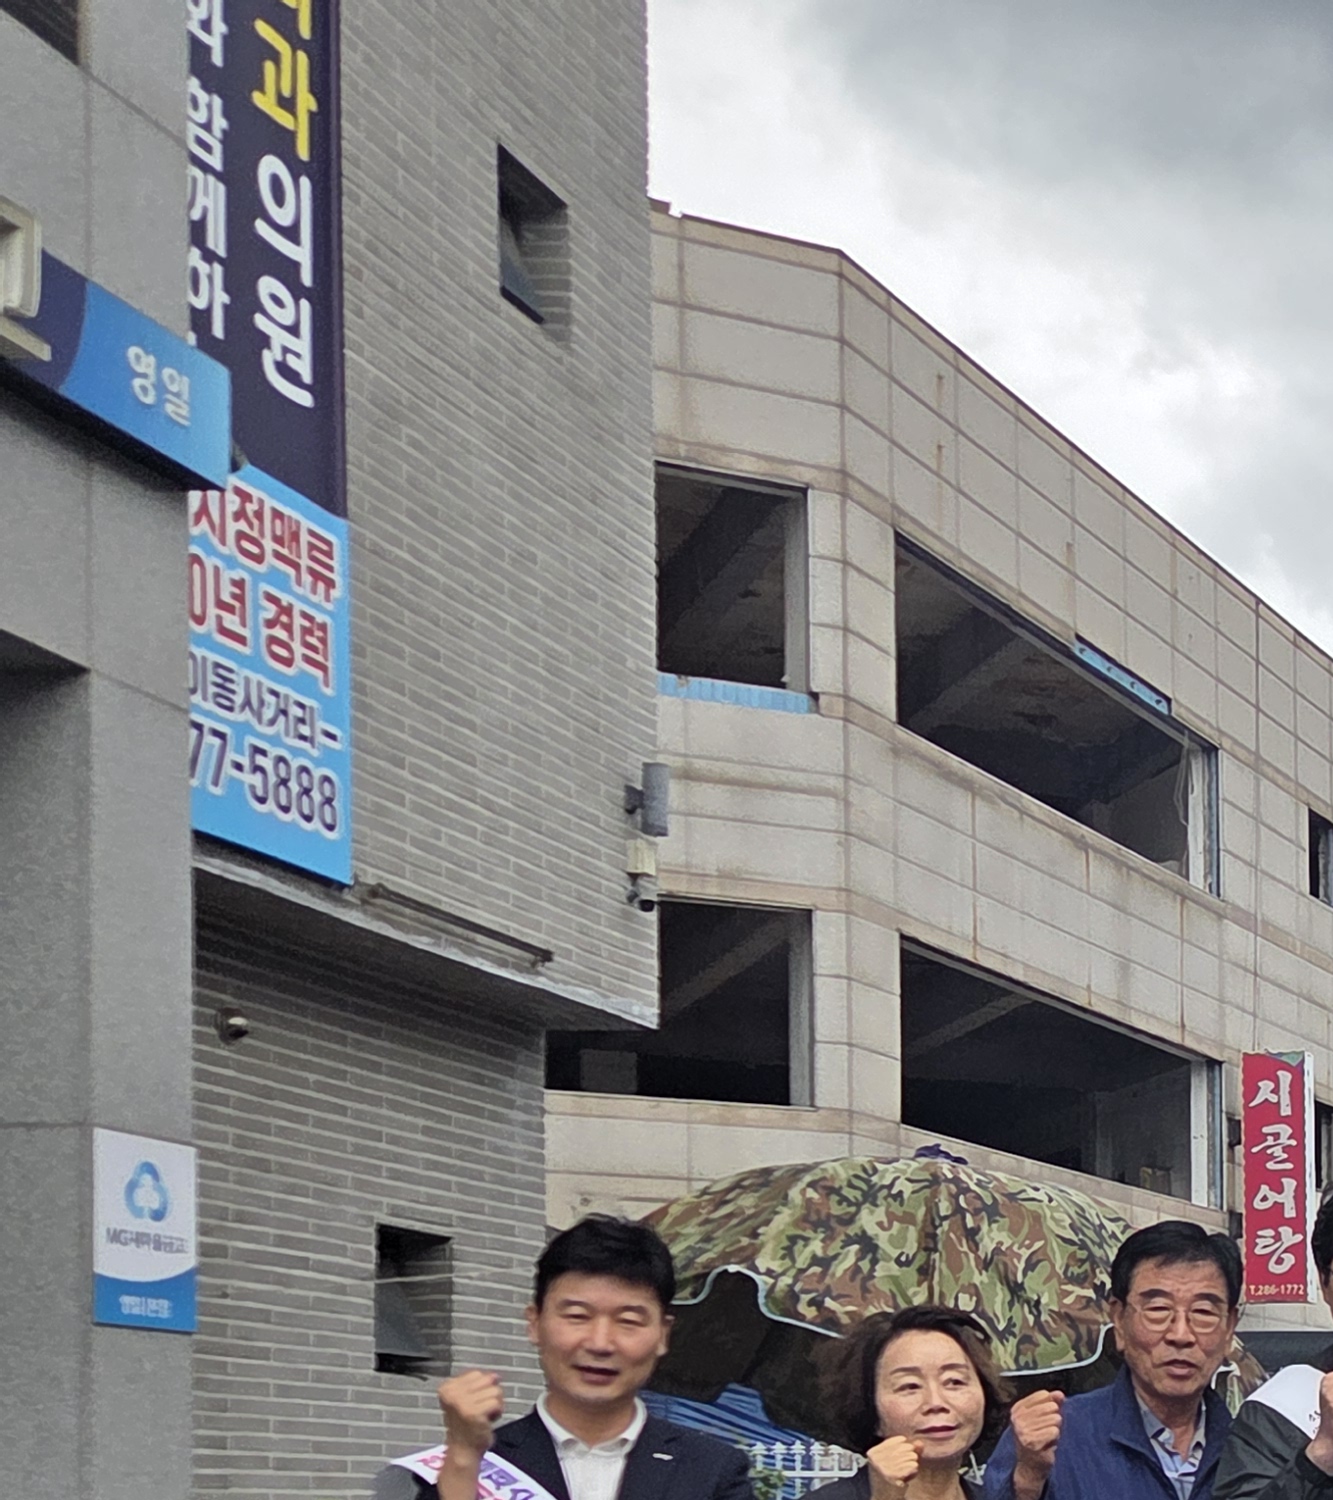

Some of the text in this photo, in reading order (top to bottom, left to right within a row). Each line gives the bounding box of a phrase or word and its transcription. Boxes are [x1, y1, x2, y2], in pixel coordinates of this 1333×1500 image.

[127, 345, 192, 427] 영일
[262, 590, 331, 690] 경력
[1248, 1069, 1304, 1275] 시골어탕
